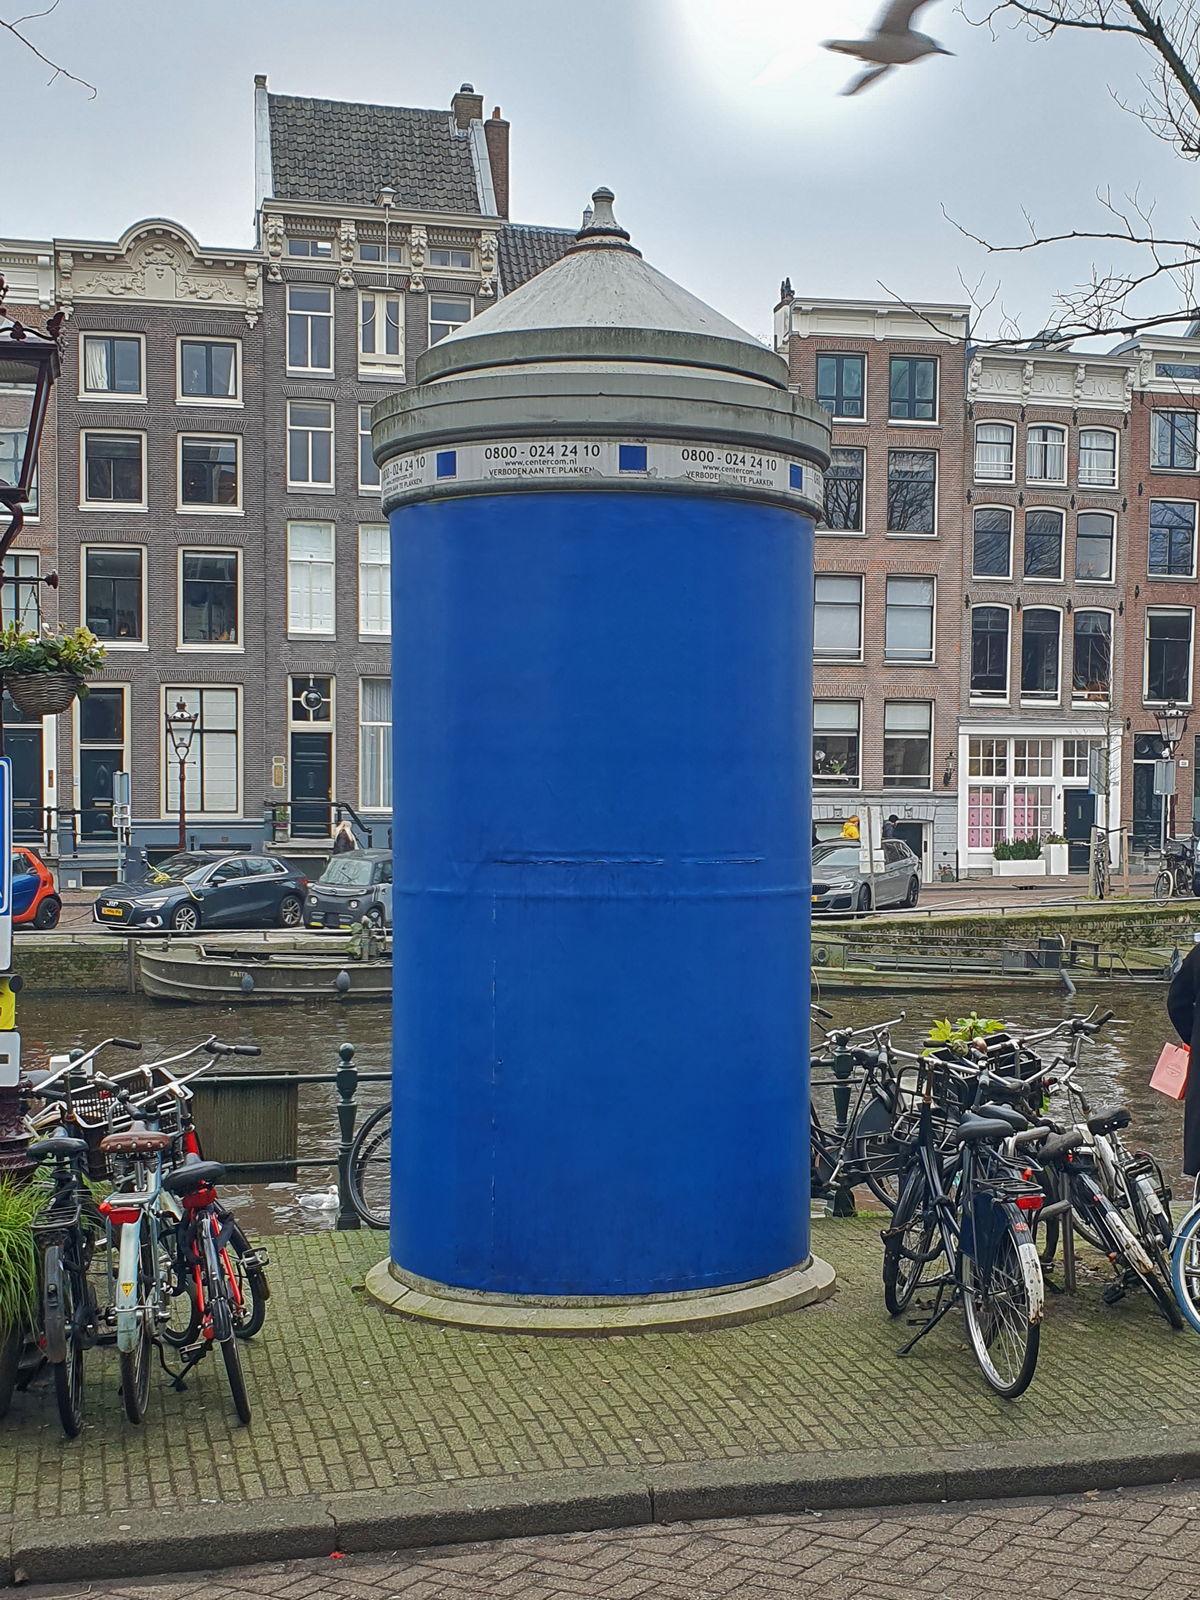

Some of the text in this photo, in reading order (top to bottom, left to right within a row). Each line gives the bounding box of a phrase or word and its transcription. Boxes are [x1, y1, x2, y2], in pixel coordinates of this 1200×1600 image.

[484, 446, 517, 459] 0800
[529, 444, 555, 457] 024
[561, 444, 578, 457] 24
[583, 444, 600, 457] 10
[405, 460, 413, 471] 24
[415, 456, 426, 469] 10
[504, 458, 577, 466] www.centercom.nl
[681, 448, 714, 463] 0800
[725, 452, 746, 466] 024
[750, 455, 763, 469] 24
[766, 459, 777, 471] 10
[489, 467, 528, 476] VERBODEN
[547, 466, 556, 474] TE
[702, 464, 762, 476] www.centercom.nl
[686, 470, 721, 480] VERBODE
[739, 475, 747, 483] TE
[749, 477, 774, 487] PLAKKEN
